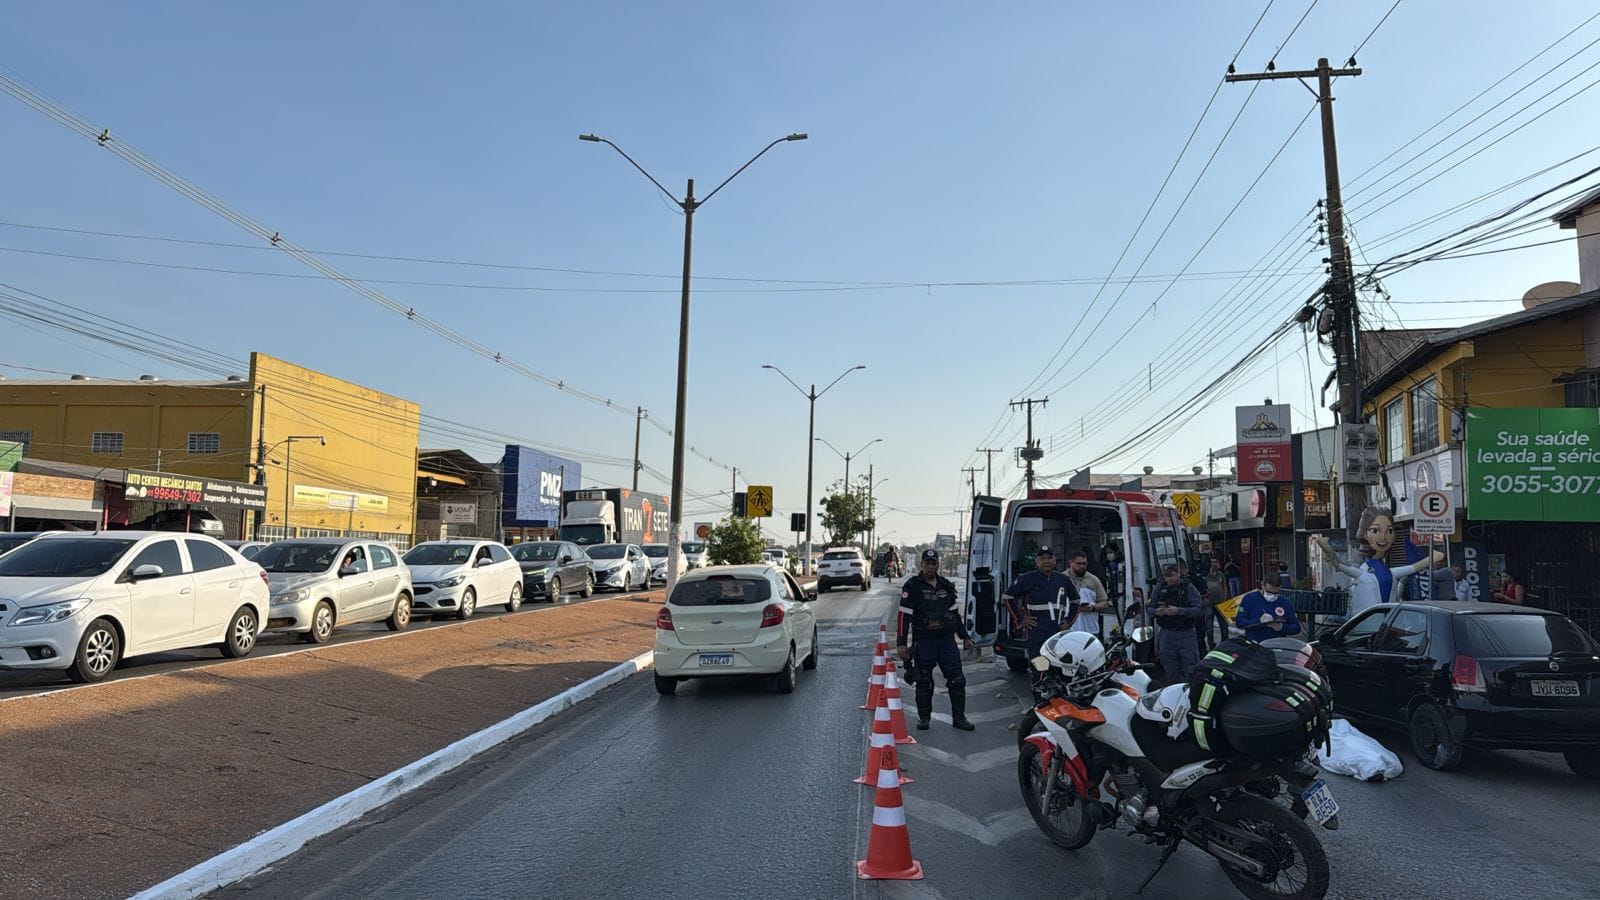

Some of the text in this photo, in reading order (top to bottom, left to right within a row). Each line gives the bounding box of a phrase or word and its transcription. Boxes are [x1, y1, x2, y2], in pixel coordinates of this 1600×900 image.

[1497, 430, 1590, 446] Sua saúde
[1477, 448, 1537, 463] levada
[1541, 451, 1553, 463] a
[540, 471, 561, 498] PMZ
[1481, 475, 1600, 494] 3055-307
[154, 487, 202, 503] 99649-7302
[1429, 497, 1440, 512] E
[623, 507, 643, 531] TRAN
[653, 511, 669, 532] SETE
[1464, 547, 1481, 600] DROG
[1310, 789, 1329, 809] RAZ
[1315, 798, 1337, 821] 8E50
